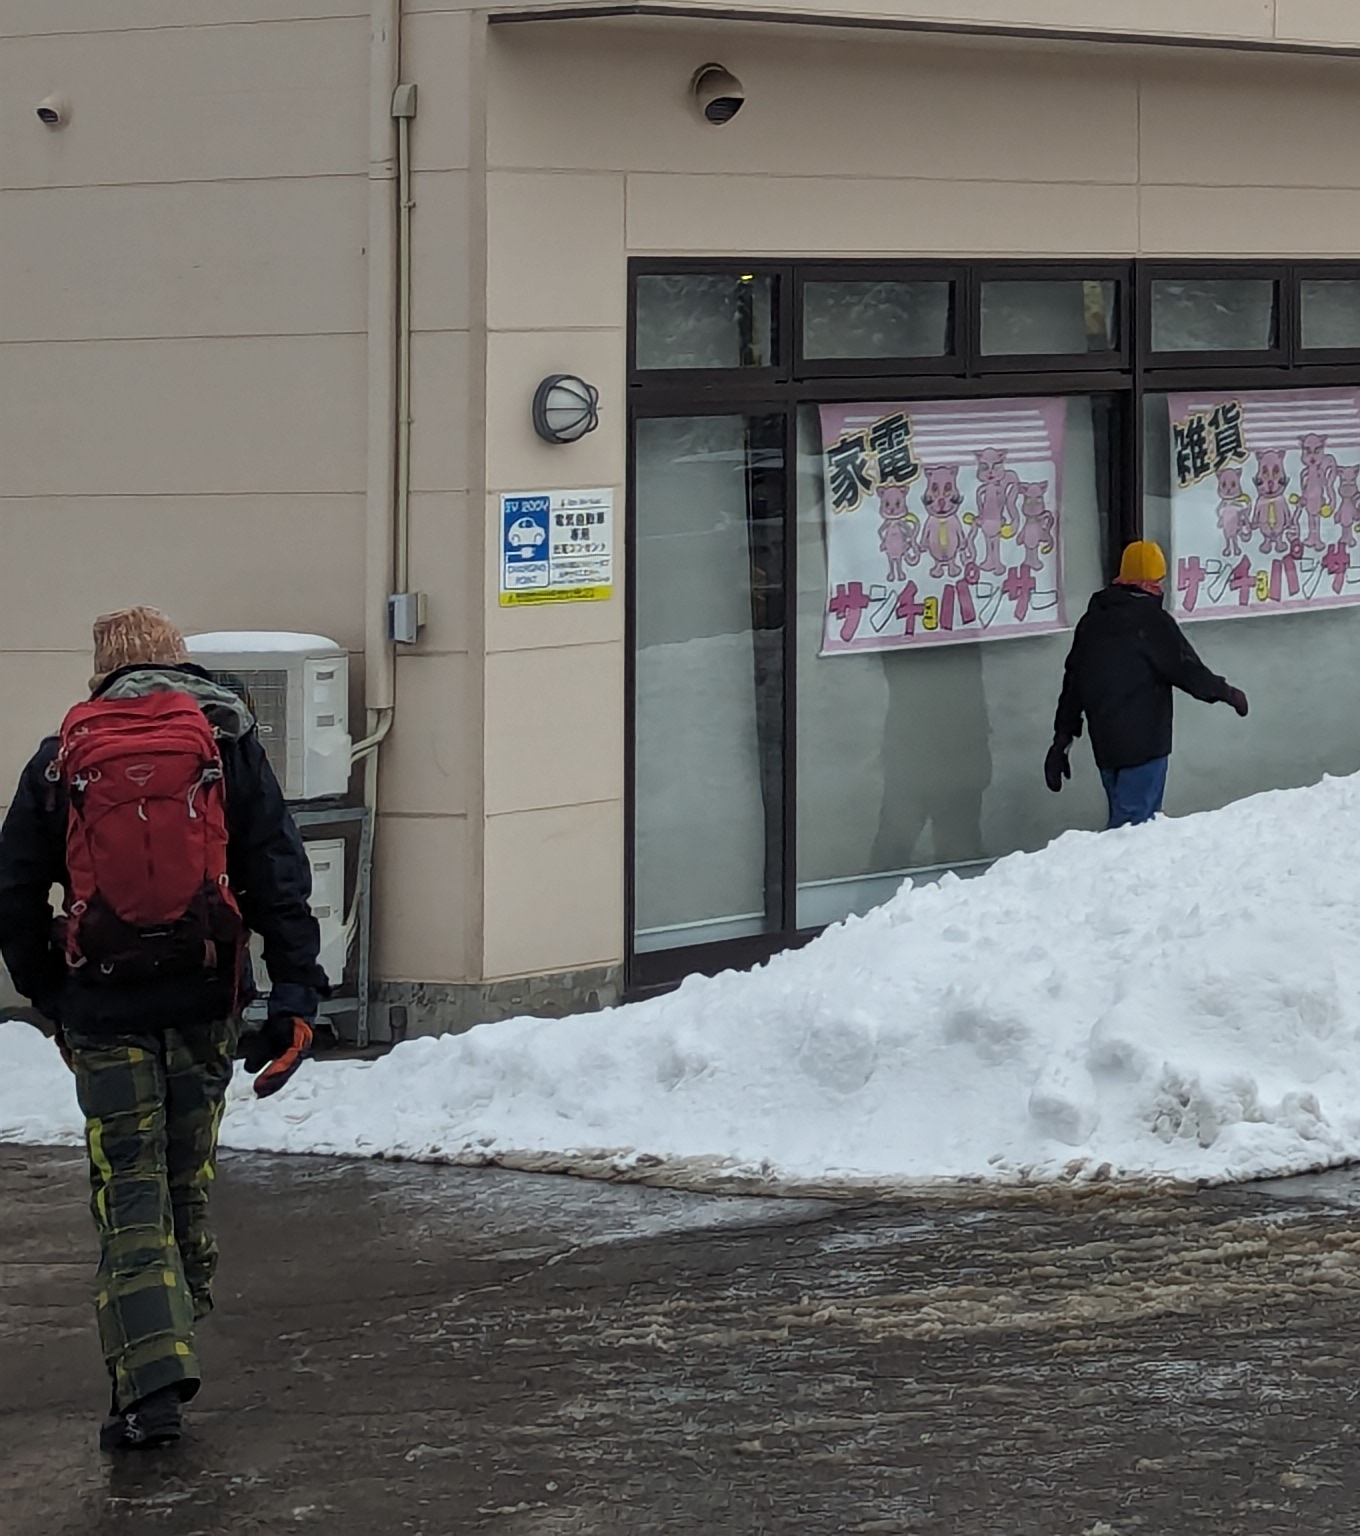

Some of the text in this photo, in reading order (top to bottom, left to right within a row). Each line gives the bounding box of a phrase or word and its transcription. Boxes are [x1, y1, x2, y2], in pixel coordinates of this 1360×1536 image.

[828, 412, 921, 511] 家電
[1173, 401, 1246, 483] 雑貨
[828, 562, 1059, 643] サンチョパンサー
